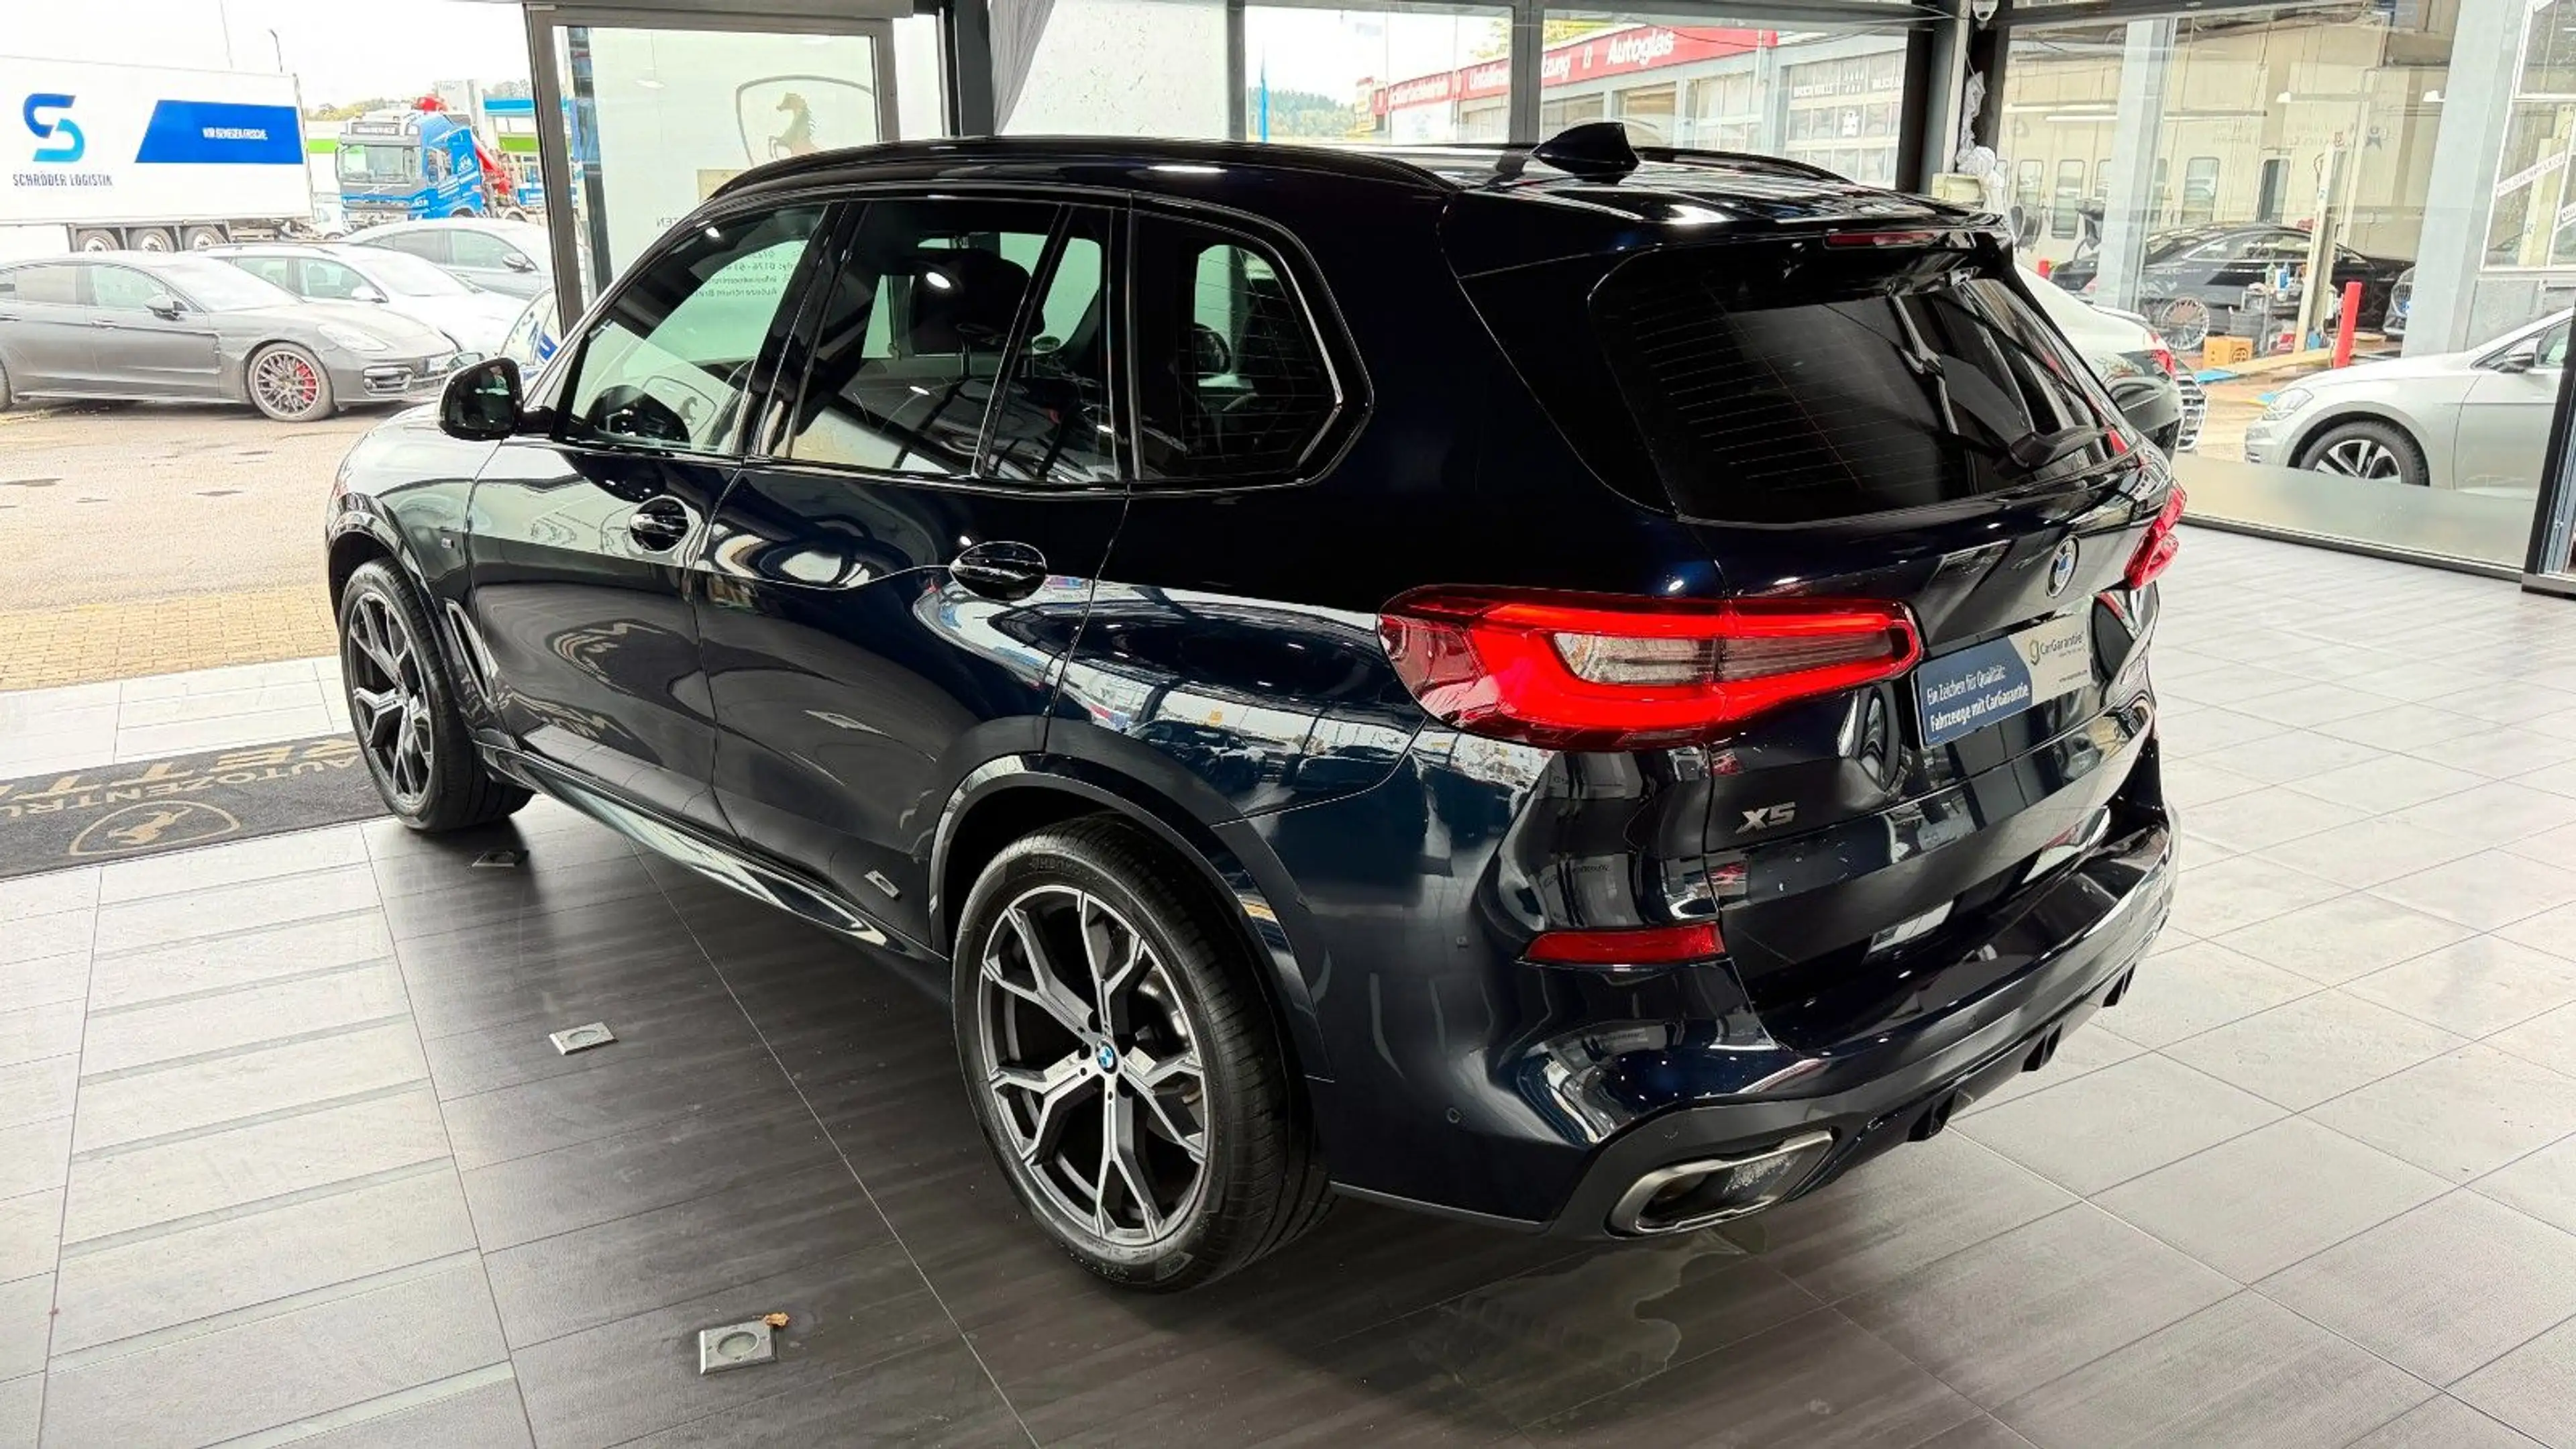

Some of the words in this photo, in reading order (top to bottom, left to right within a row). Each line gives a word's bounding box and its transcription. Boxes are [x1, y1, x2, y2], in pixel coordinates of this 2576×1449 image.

[1606, 29, 1674, 65] Autoglas
[13, 170, 67, 186] SCHRÖDER
[69, 174, 113, 186] LOGISTIK
[1930, 706, 1972, 732] Fahrzeuge
[1971, 698, 1986, 716] mit
[1986, 682, 2029, 711] CarGarantie
[1735, 802, 1796, 835] X5
